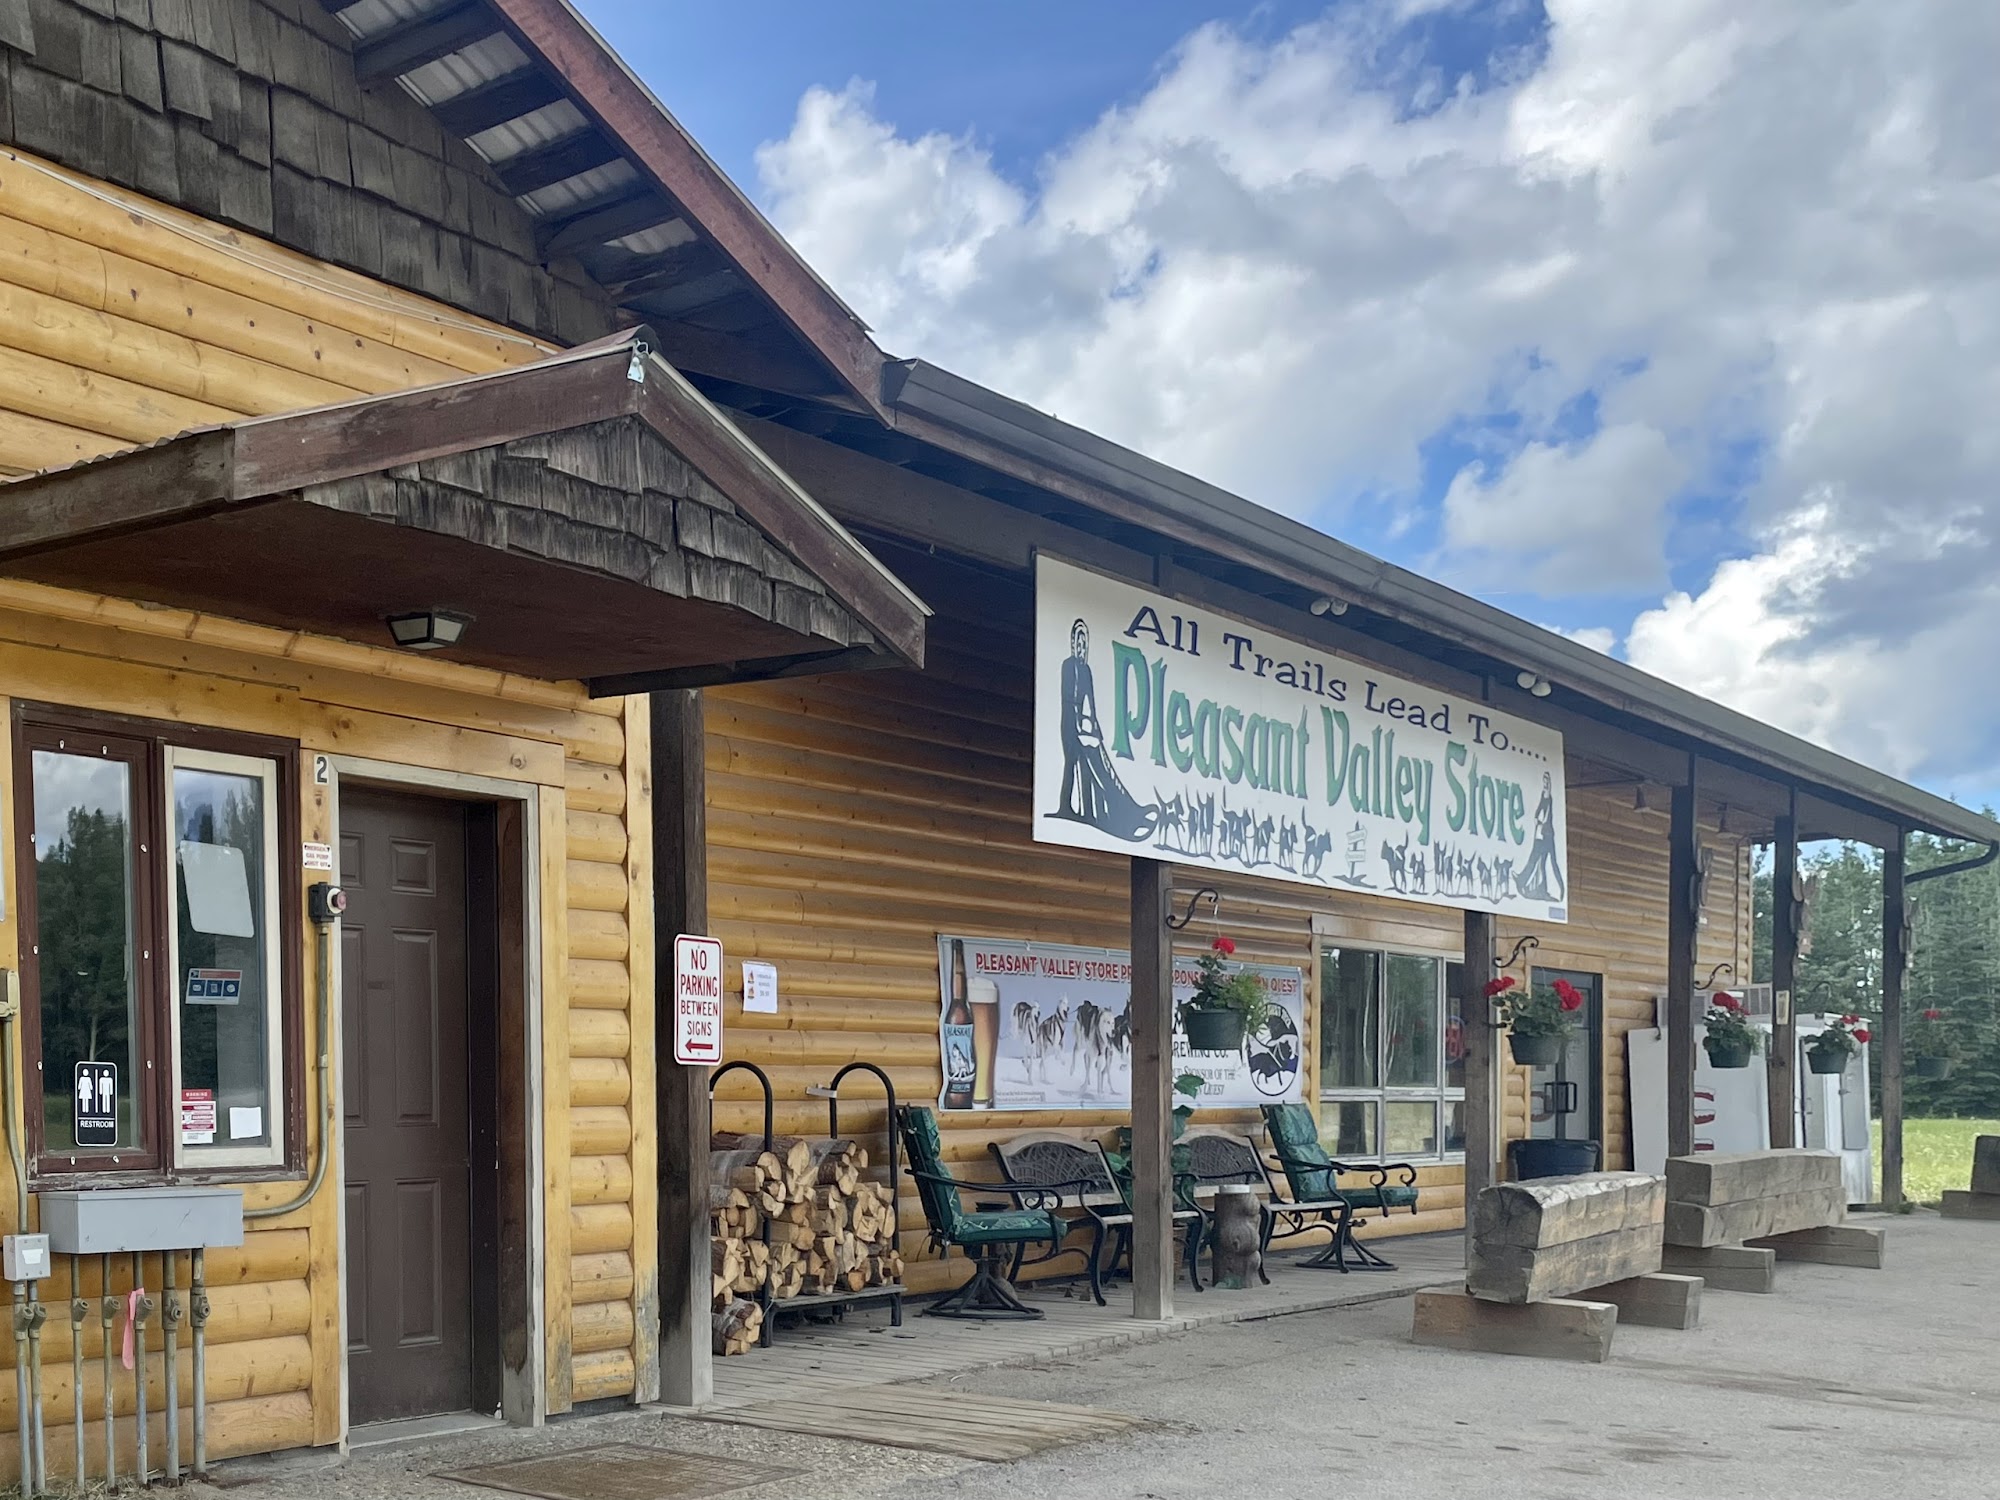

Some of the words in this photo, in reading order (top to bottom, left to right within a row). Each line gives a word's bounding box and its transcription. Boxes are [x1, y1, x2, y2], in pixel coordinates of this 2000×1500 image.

[1122, 605, 1201, 657] All
[1222, 632, 1347, 702] Trails
[1364, 680, 1452, 735] Lead
[1111, 639, 1310, 801] Pleasant
[1319, 703, 1434, 847] Valley
[1444, 740, 1526, 847] Store
[316, 756, 328, 784] 2
[691, 949, 707, 970] NO
[975, 952, 1037, 974] PLEASANT
[1039, 958, 1083, 978] VALLEY
[1085, 962, 1119, 980] STORE
[681, 974, 718, 997] PARKING
[681, 1000, 718, 1016] BETWEEN
[687, 1021, 712, 1036] SIGNS
[80, 1120, 115, 1128] RESTROOM
